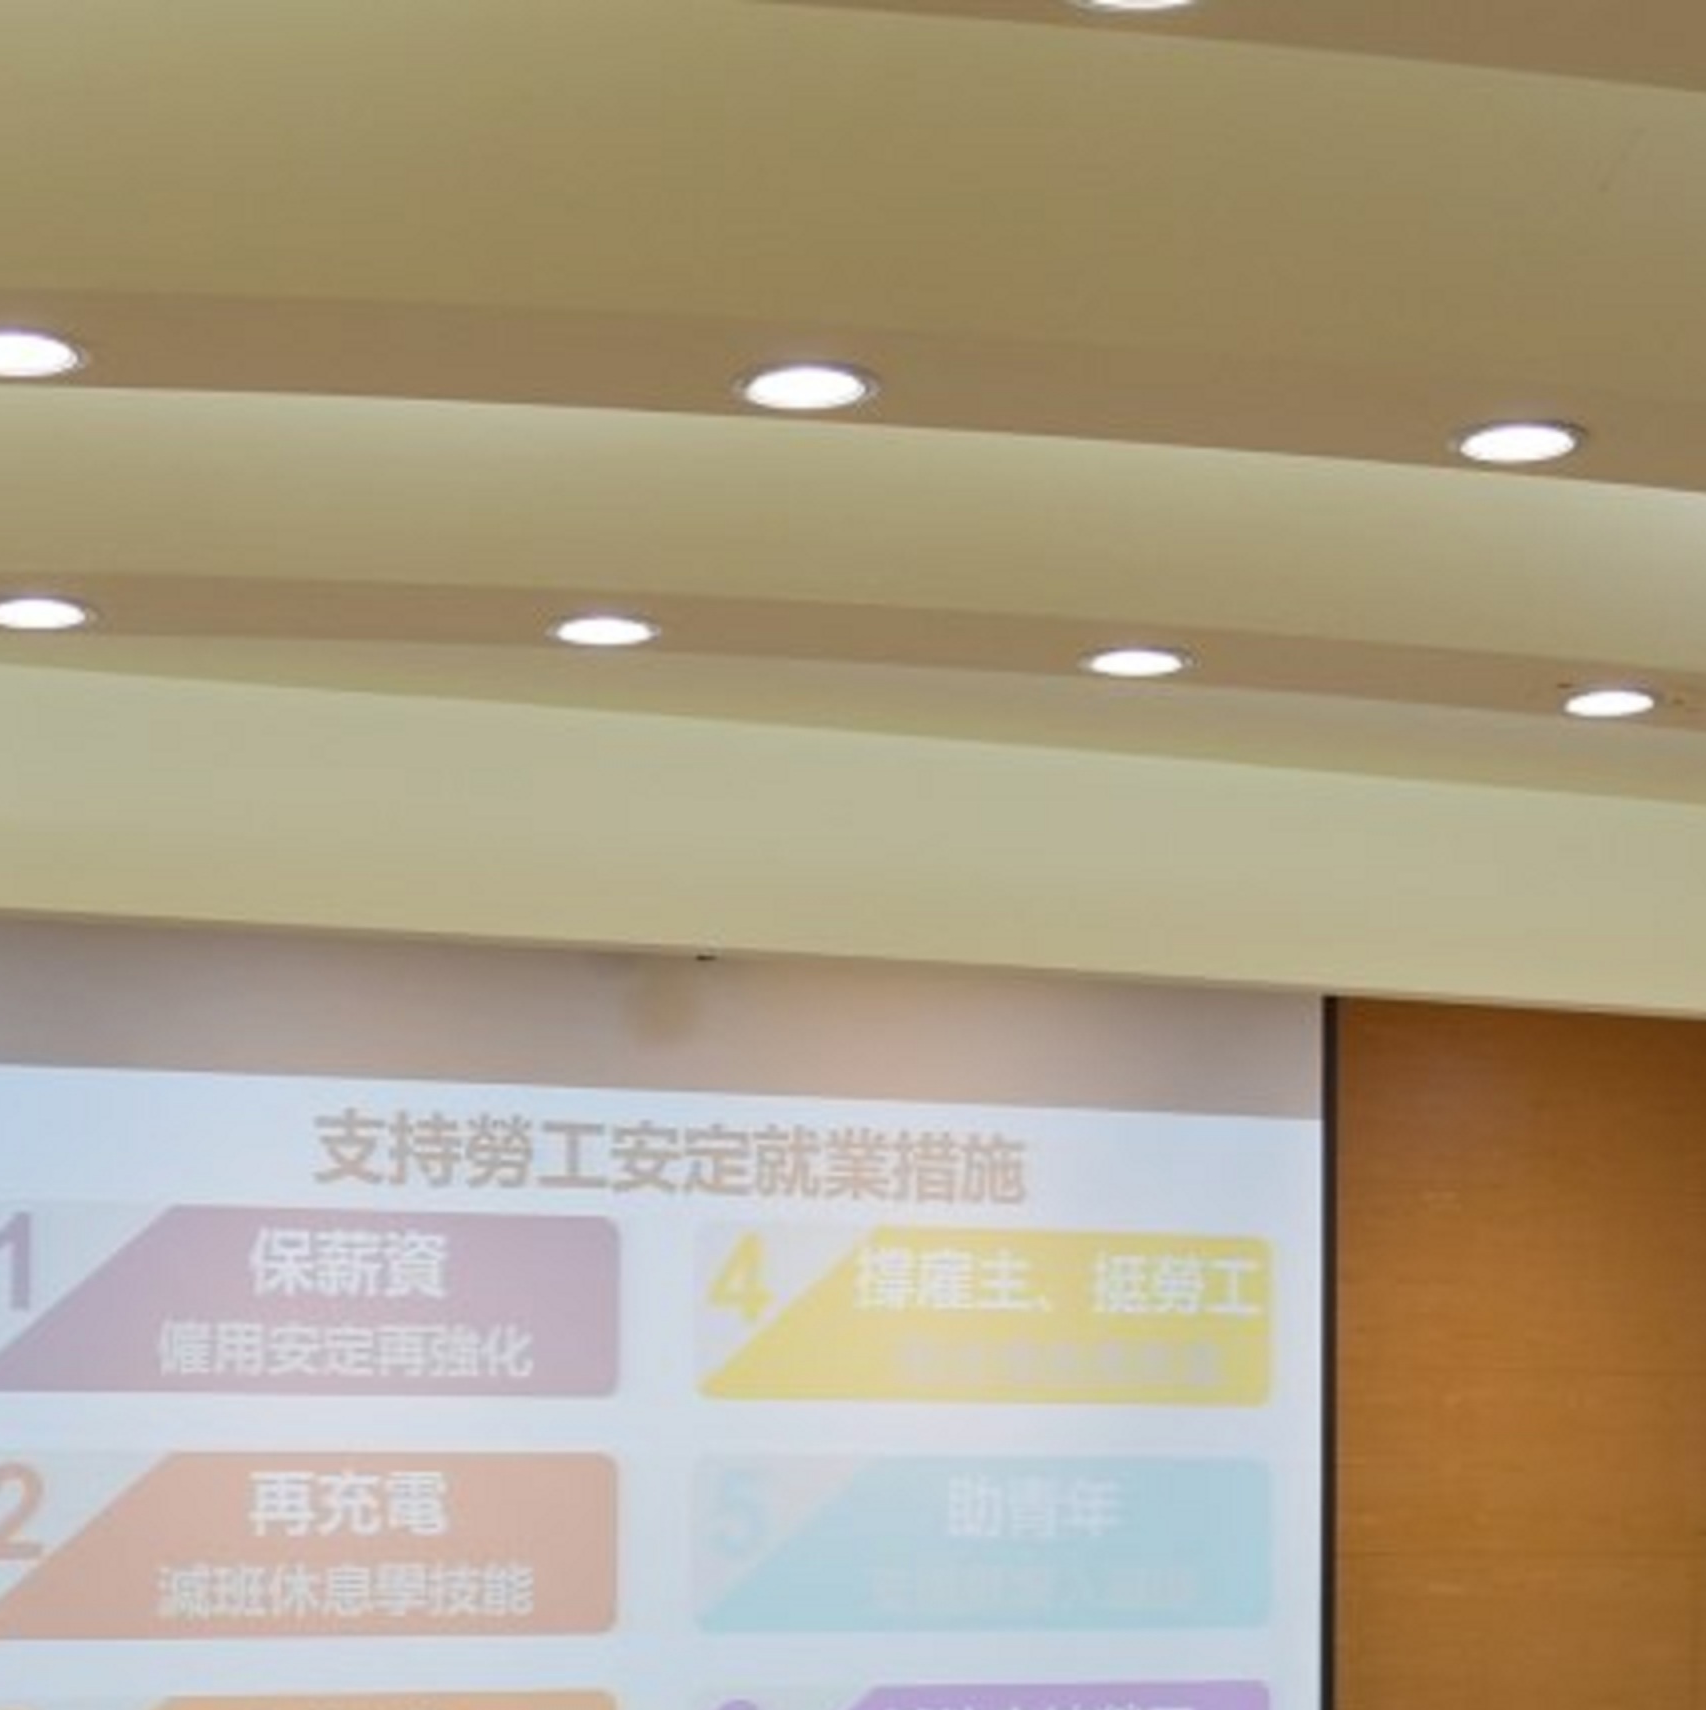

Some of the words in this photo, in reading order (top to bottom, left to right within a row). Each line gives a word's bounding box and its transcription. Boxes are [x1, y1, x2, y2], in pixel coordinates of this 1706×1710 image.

[313, 1107, 1028, 1205] 支持勞工安定就業措施
[249, 1226, 448, 1298] 保薪資
[707, 1229, 776, 1322] 4
[158, 1319, 534, 1378] 僱用安定再強化
[248, 1470, 449, 1537] 再充電
[947, 1475, 1123, 1540] 助青年
[158, 1564, 535, 1618] 減班休息學技能
